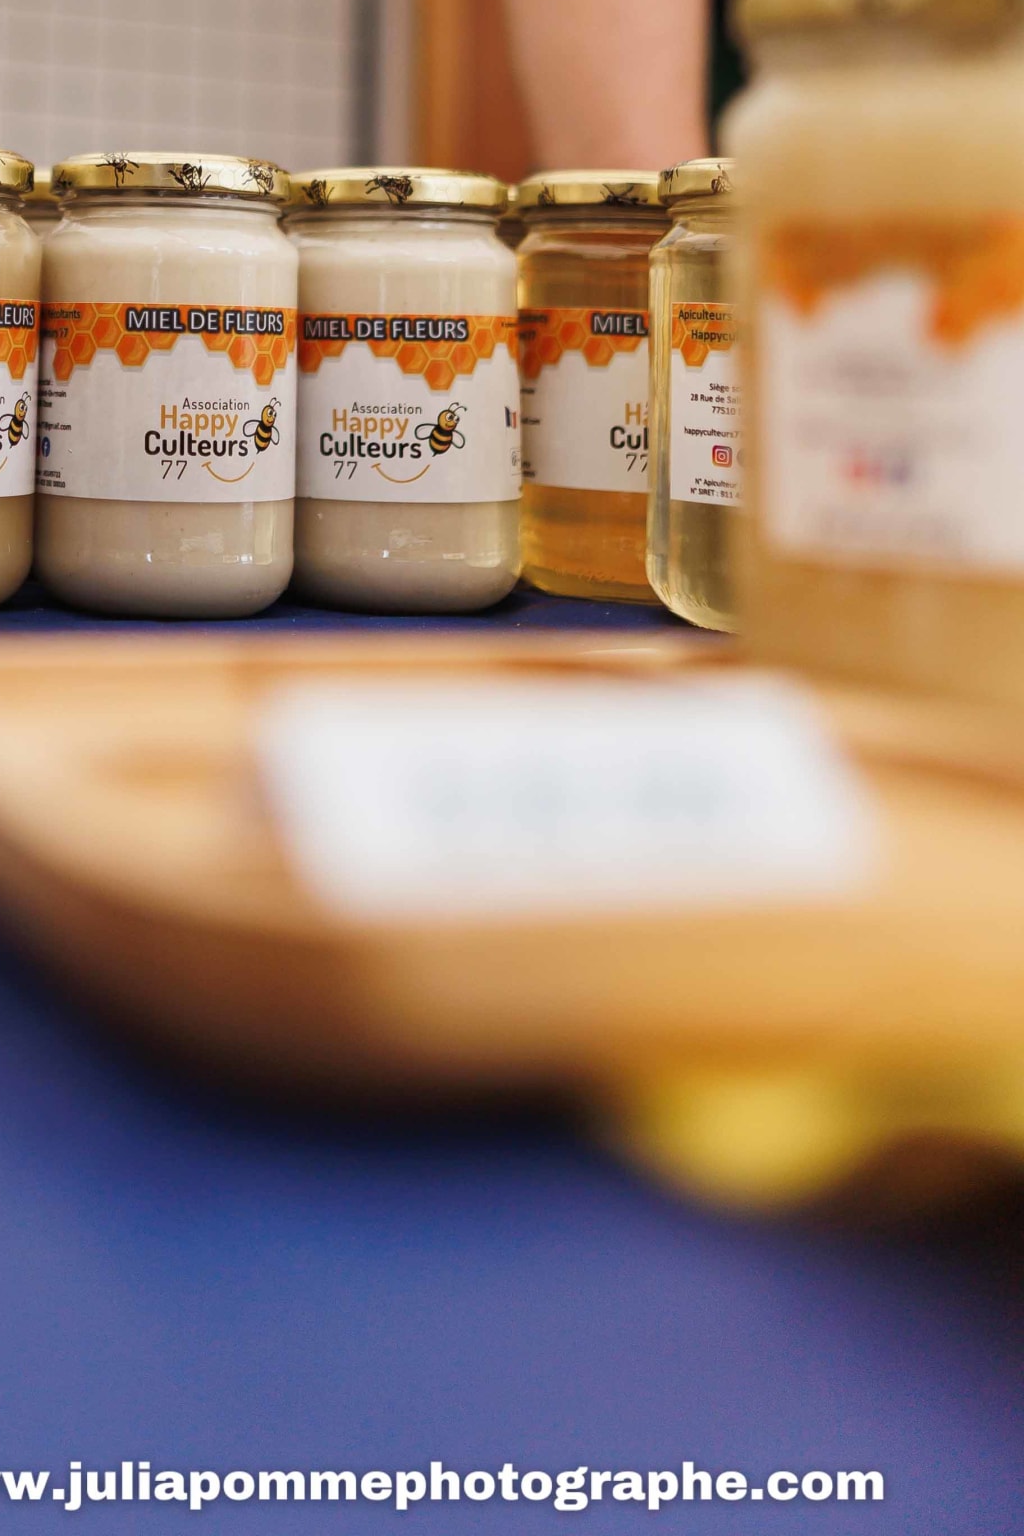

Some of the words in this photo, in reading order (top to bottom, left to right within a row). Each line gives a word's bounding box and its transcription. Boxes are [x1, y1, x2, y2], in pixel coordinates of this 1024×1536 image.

[127, 309, 184, 330] MIEL
[189, 311, 218, 331] DE
[225, 312, 284, 333] FLEURS
[592, 314, 647, 335] MIEL
[678, 309, 733, 321] Apiculteurs
[304, 319, 351, 338] MIEL
[356, 320, 385, 339] DE
[391, 320, 468, 340] FLEURS
[691, 329, 738, 343] Happycu
[690, 394, 699, 402] 28
[700, 394, 714, 403] Rue
[715, 395, 725, 403] de
[709, 383, 730, 394] Siège
[182, 396, 250, 411] Association
[351, 401, 423, 415] Association
[711, 406, 736, 415] 77510
[159, 404, 239, 438] Happy
[331, 408, 409, 440] Happy
[683, 427, 743, 439] happyculteurs7
[144, 430, 249, 457] Culteurs
[319, 432, 423, 459] Culteurs
[160, 459, 188, 481] 77
[333, 460, 358, 480] 77
